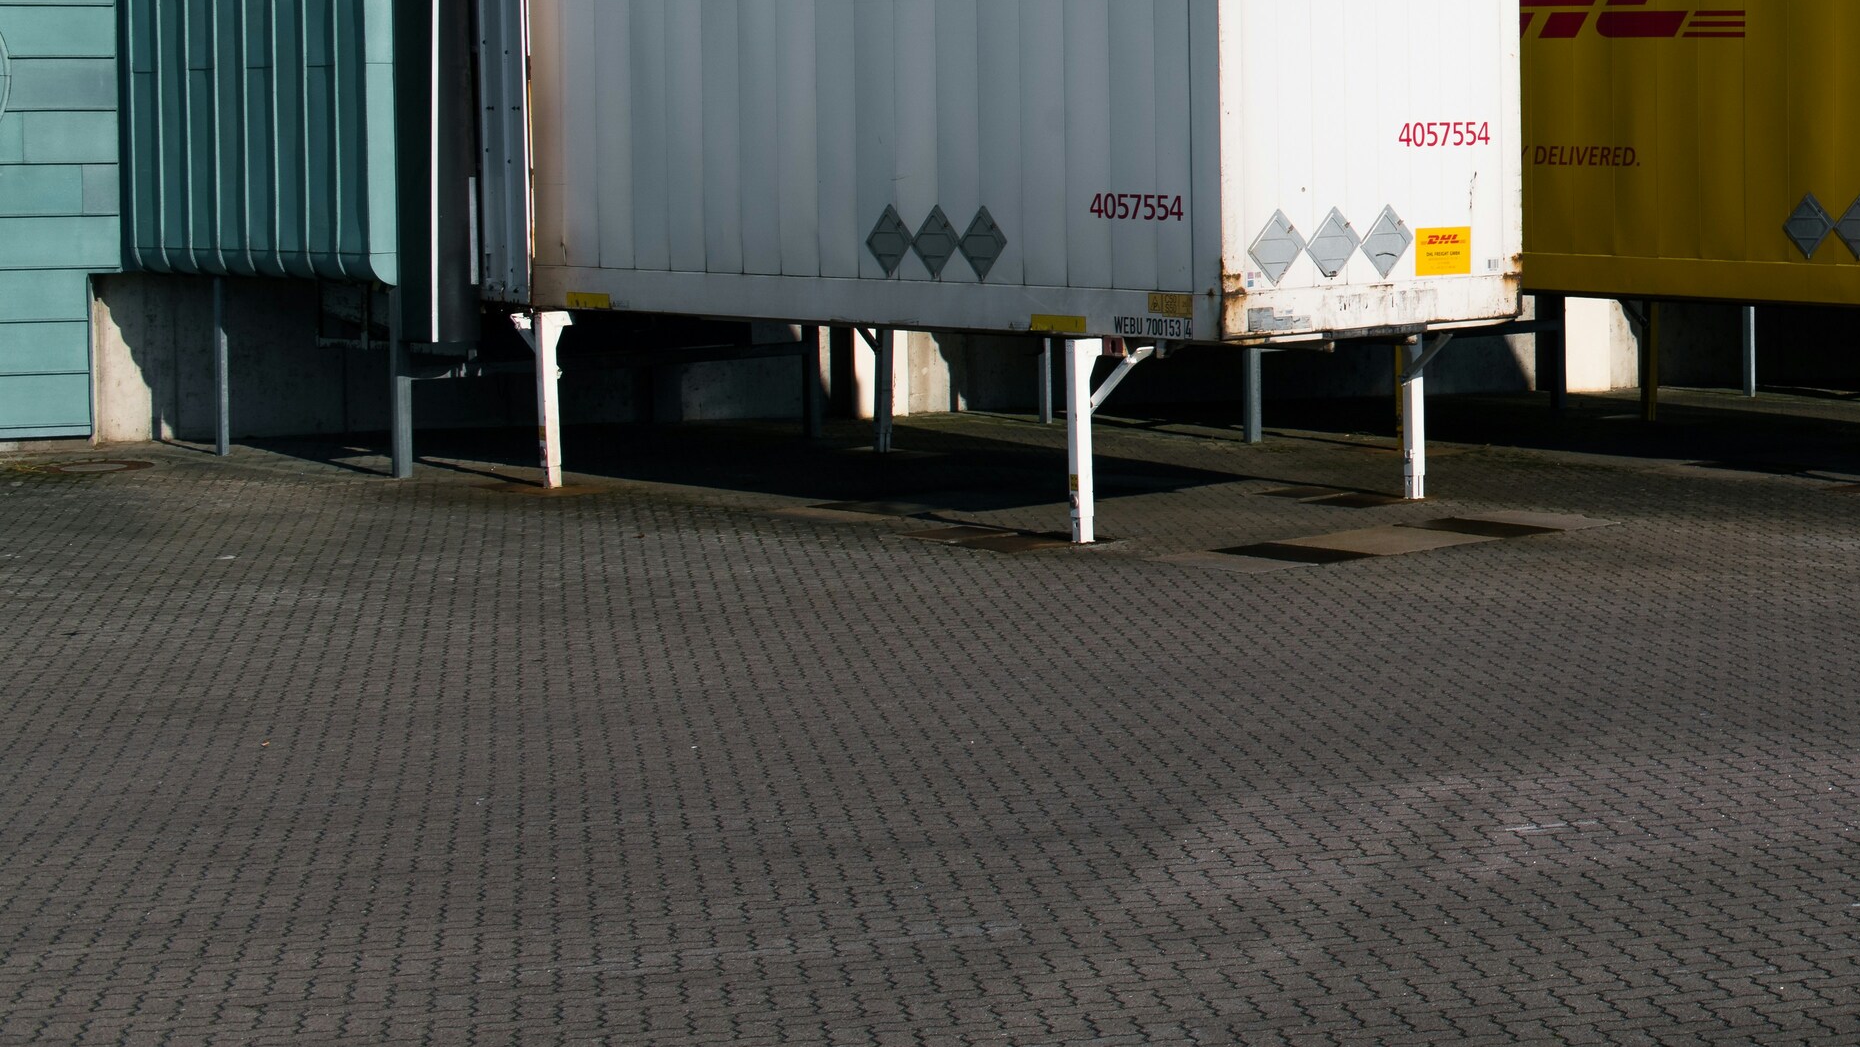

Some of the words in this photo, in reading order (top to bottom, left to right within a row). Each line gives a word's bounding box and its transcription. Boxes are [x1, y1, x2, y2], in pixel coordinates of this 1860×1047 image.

[1398, 121, 1491, 148] 4057554
[1534, 145, 1640, 167] DELIVERED.
[1089, 193, 1184, 222] 4057554
[1427, 234, 1460, 245] DHL
[1114, 316, 1143, 335] WEBU
[1146, 318, 1181, 337] 700153
